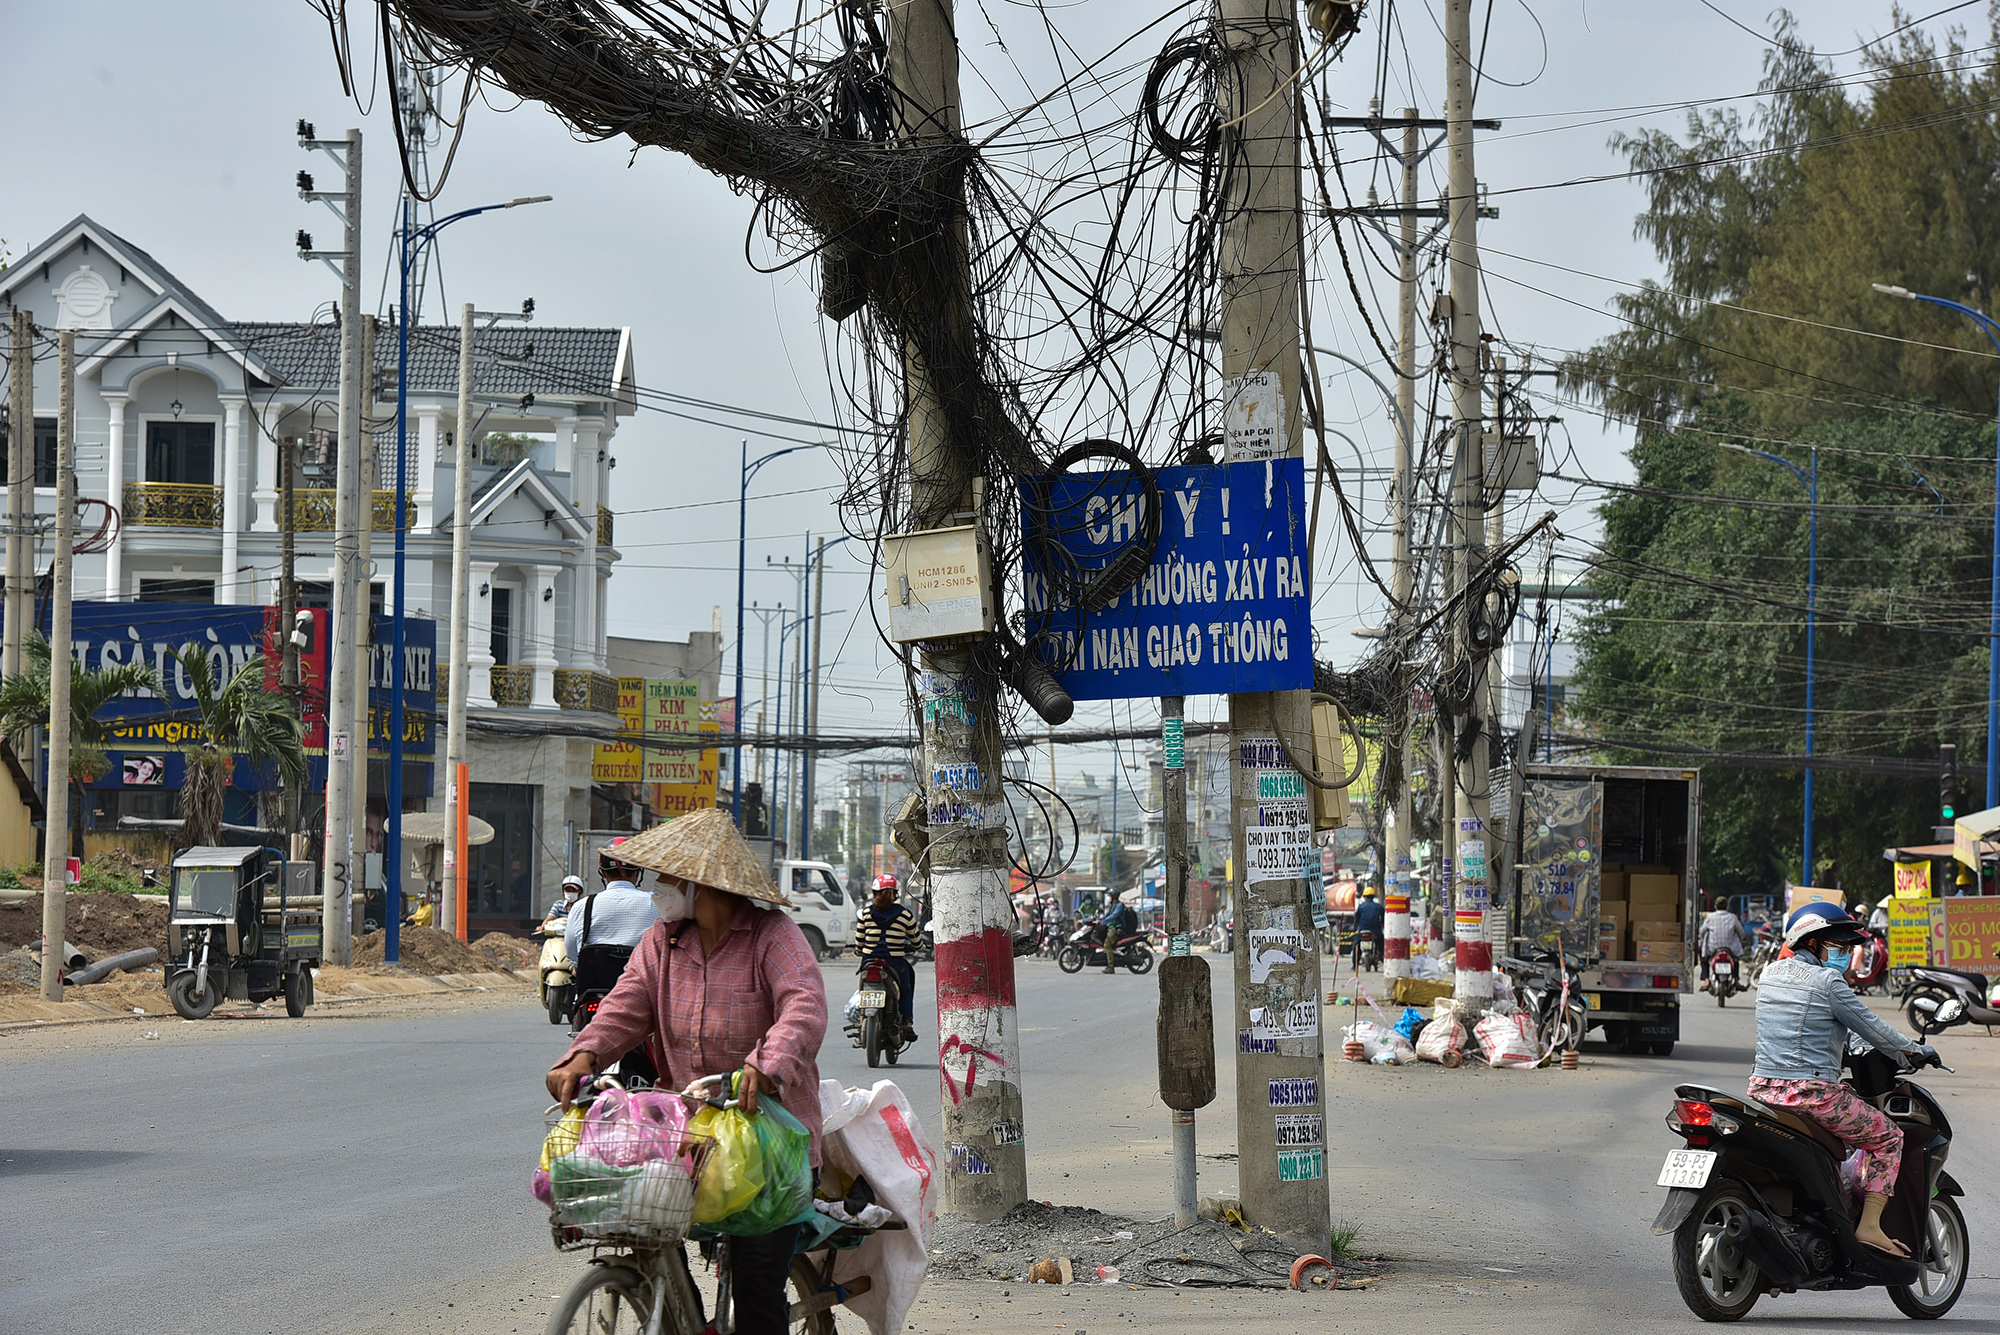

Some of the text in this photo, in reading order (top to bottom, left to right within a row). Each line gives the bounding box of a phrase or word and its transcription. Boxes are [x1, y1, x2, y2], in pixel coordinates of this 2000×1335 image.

[918, 565, 966, 577] HCM1286
[1225, 543, 1268, 601] XẢY
[1276, 556, 1305, 598] RA
[1092, 626, 1139, 675] NẠN
[1147, 622, 1201, 668] GIAO
[1208, 612, 1289, 663] THÔNG
[617, 695, 636, 708] IM
[660, 700, 685, 715] KIM
[655, 716, 690, 733] PHÁT
[1248, 832, 1263, 846] CHO
[1264, 832, 1279, 846] VAY
[1949, 916, 1976, 936] XỐI
[1951, 938, 1982, 960] Dì
[1642, 1027, 1674, 1035] ISUZU
[1673, 1154, 1708, 1169] 59-P3
[1663, 1169, 1705, 1184] 113.61
